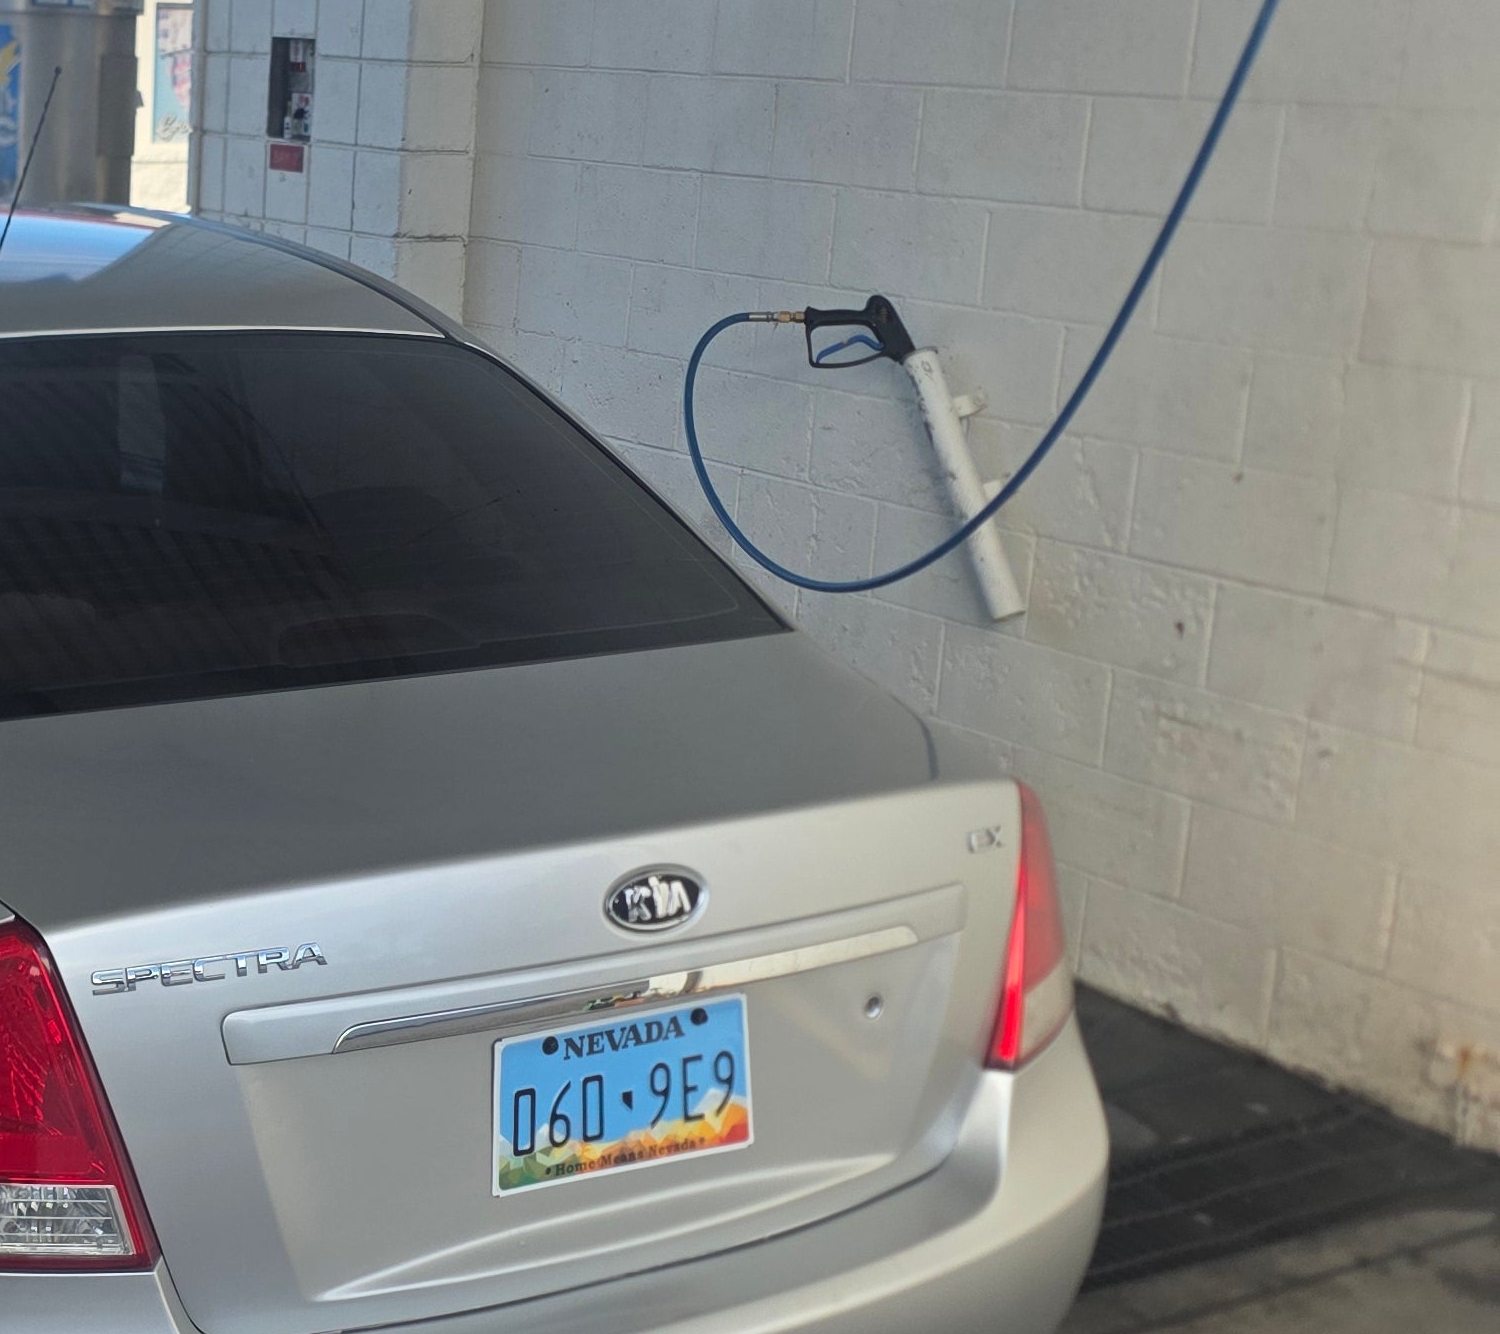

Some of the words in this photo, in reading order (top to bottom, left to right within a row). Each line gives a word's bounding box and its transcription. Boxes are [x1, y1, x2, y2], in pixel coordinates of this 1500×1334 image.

[623, 875, 693, 923] KIA
[90, 941, 329, 996] SPECTRA
[563, 1015, 685, 1060] NEVADA
[555, 1160, 596, 1176] Home
[600, 1150, 644, 1167] Means
[649, 1138, 696, 1155] Nevada
